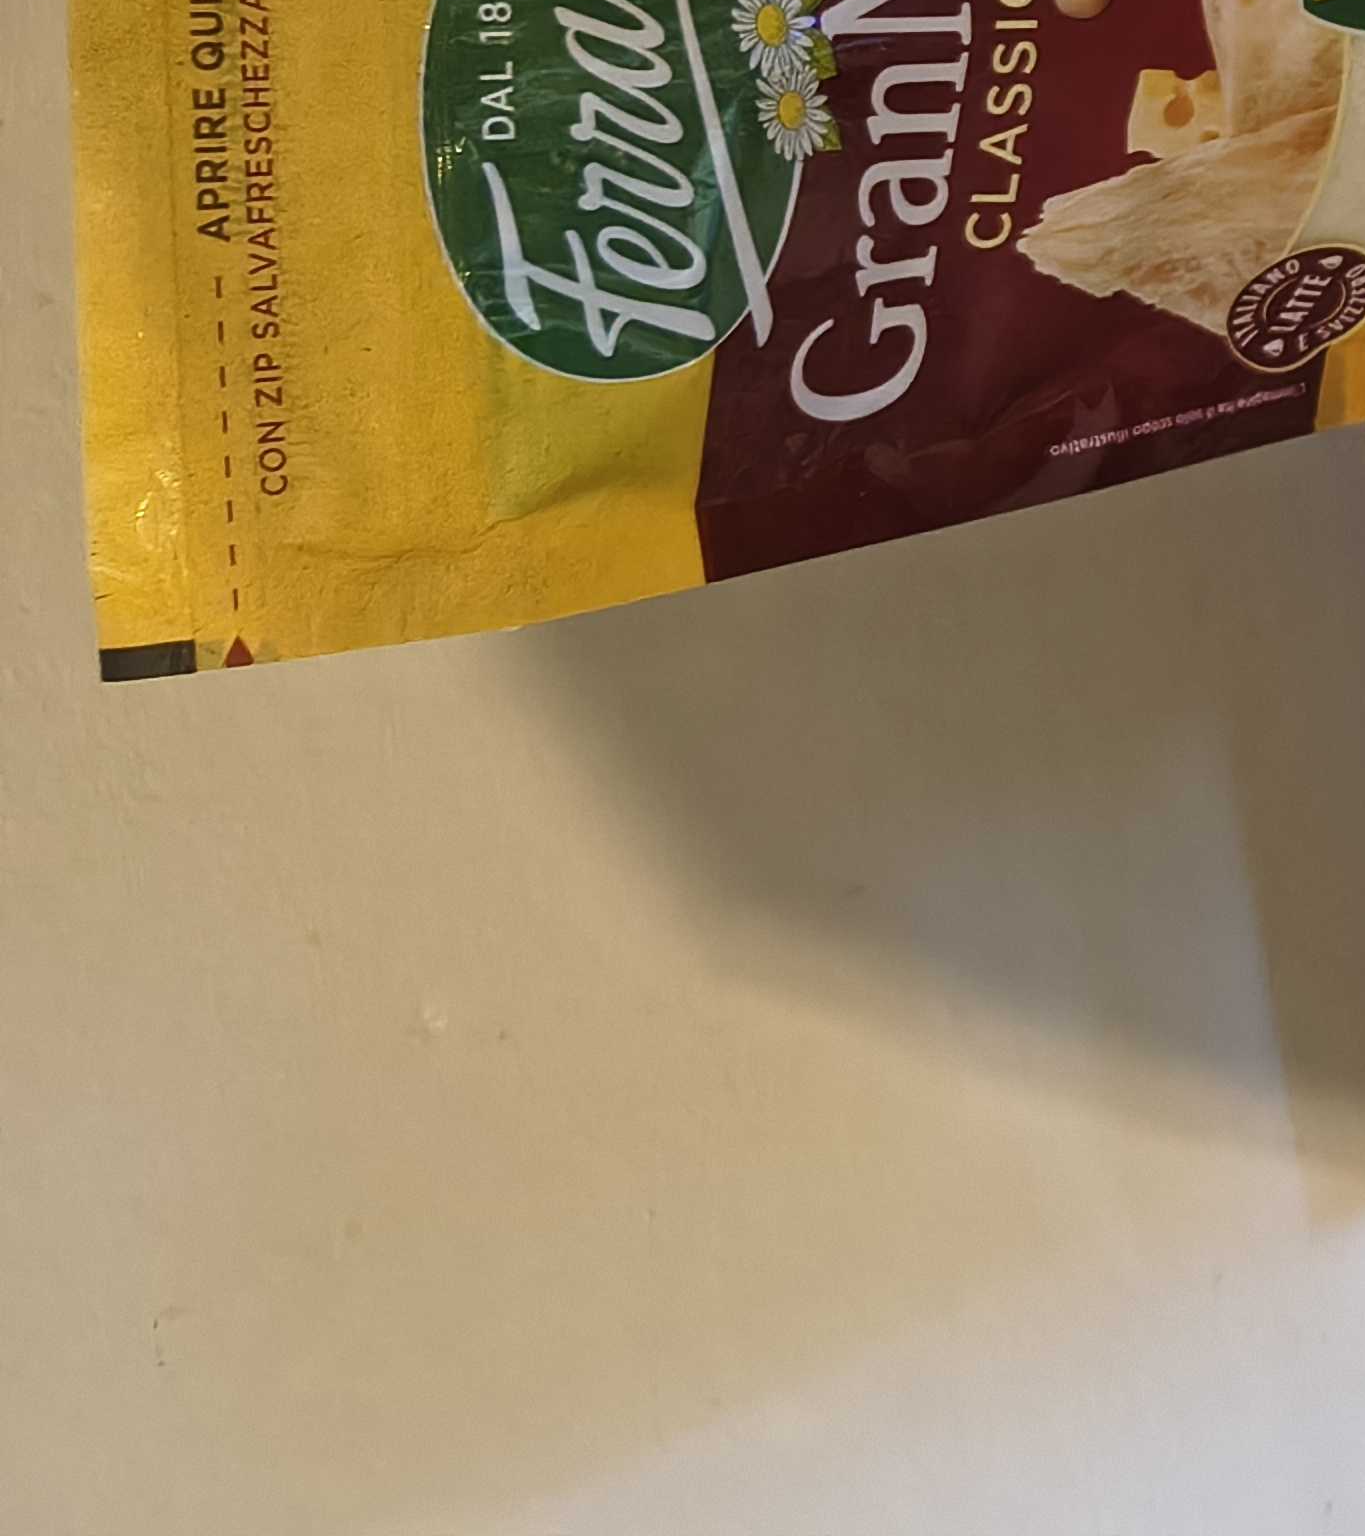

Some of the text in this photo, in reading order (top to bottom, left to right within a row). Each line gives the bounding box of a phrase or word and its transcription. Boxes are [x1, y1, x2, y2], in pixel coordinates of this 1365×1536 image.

[480, 60, 517, 140] DAL
[193, 86, 231, 242] APRIRE
[1232, 257, 1300, 347] ITALIANO
[1268, 273, 1335, 331] LATTE
[252, 351, 284, 407] ZIP
[255, 419, 290, 495] CON
